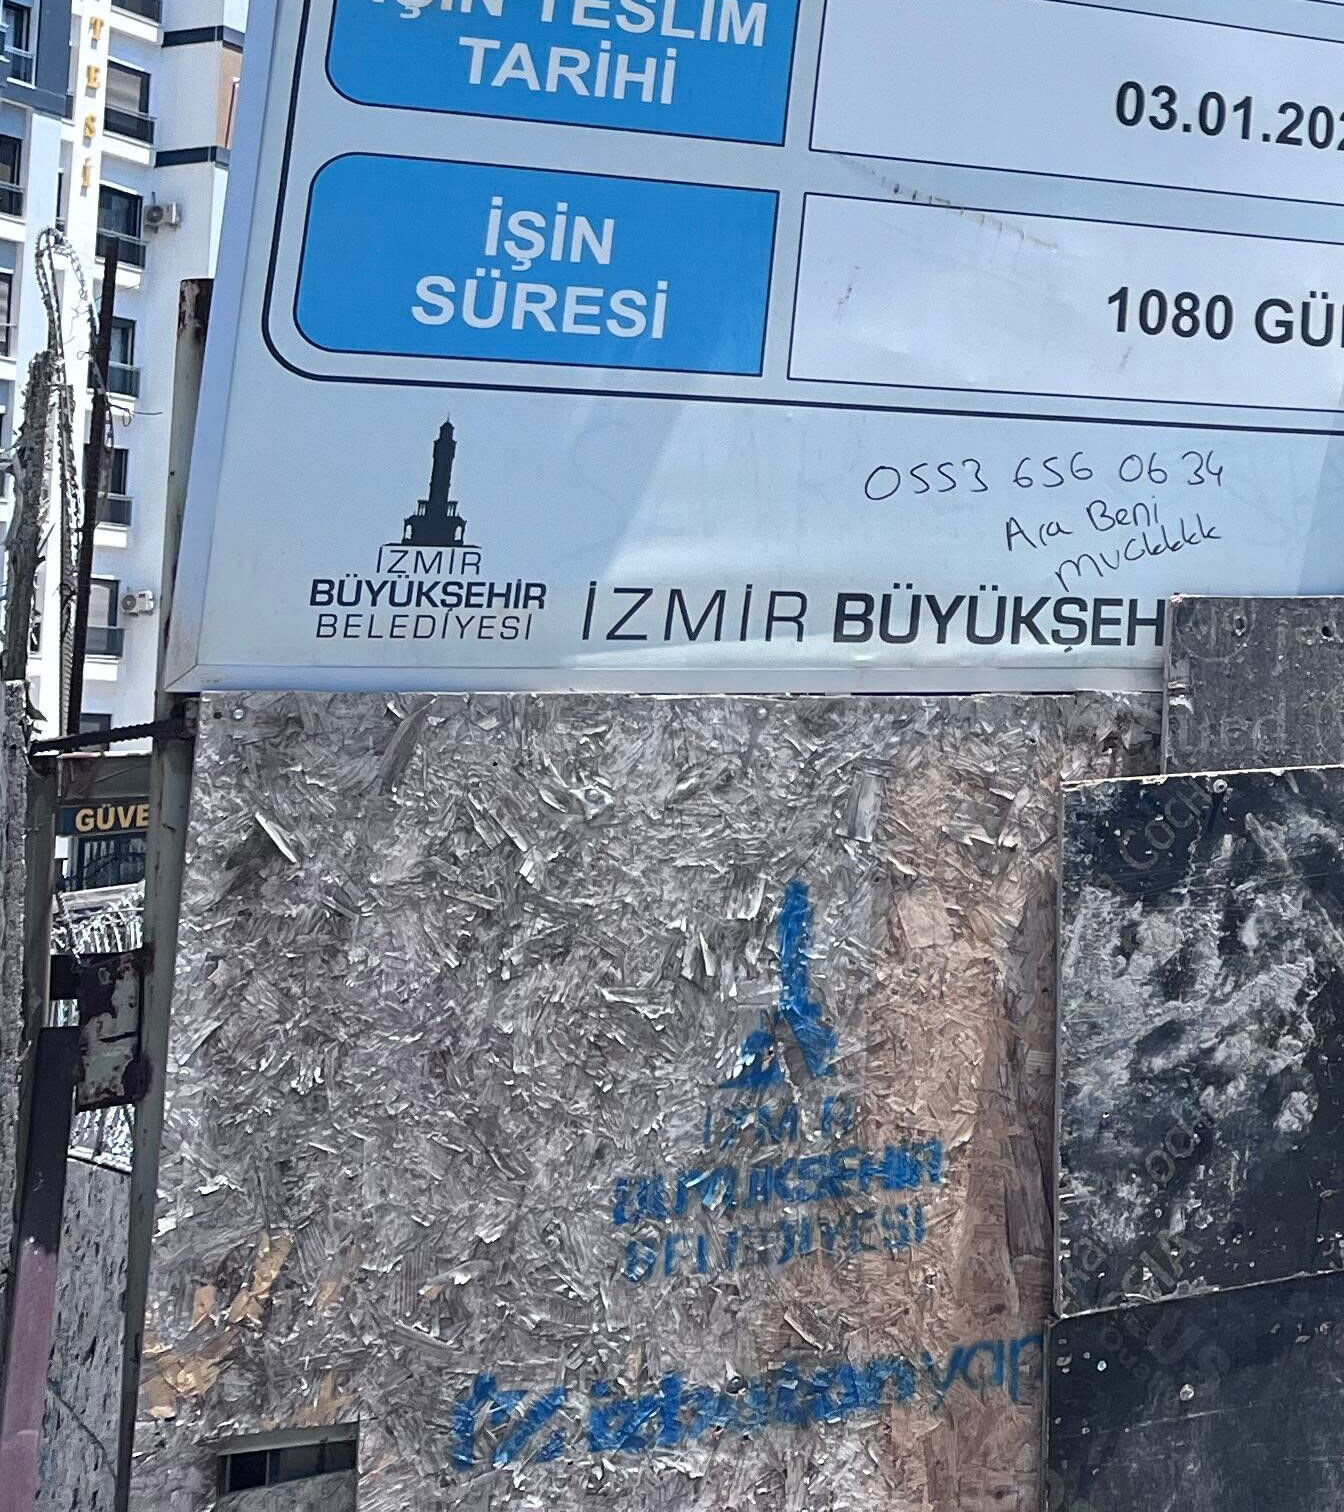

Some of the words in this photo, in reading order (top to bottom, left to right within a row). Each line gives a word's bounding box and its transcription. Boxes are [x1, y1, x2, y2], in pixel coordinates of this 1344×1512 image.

[459, 37, 677, 104] TARİHİ
[485, 197, 614, 270] İŞİN
[412, 268, 667, 338] SÜRESİ
[1108, 287, 1233, 340] 1080
[865, 459, 988, 500] 0553
[1013, 452, 1093, 488] 656
[1085, 495, 1160, 533] Beni
[376, 545, 482, 576] İZMİR
[309, 573, 547, 612] BÜYÜKŞEHİR
[582, 581, 807, 642] İZMİR
[833, 583, 1166, 653] BÜYÜKŞEH
[316, 610, 533, 641] BELEDİYESİ
